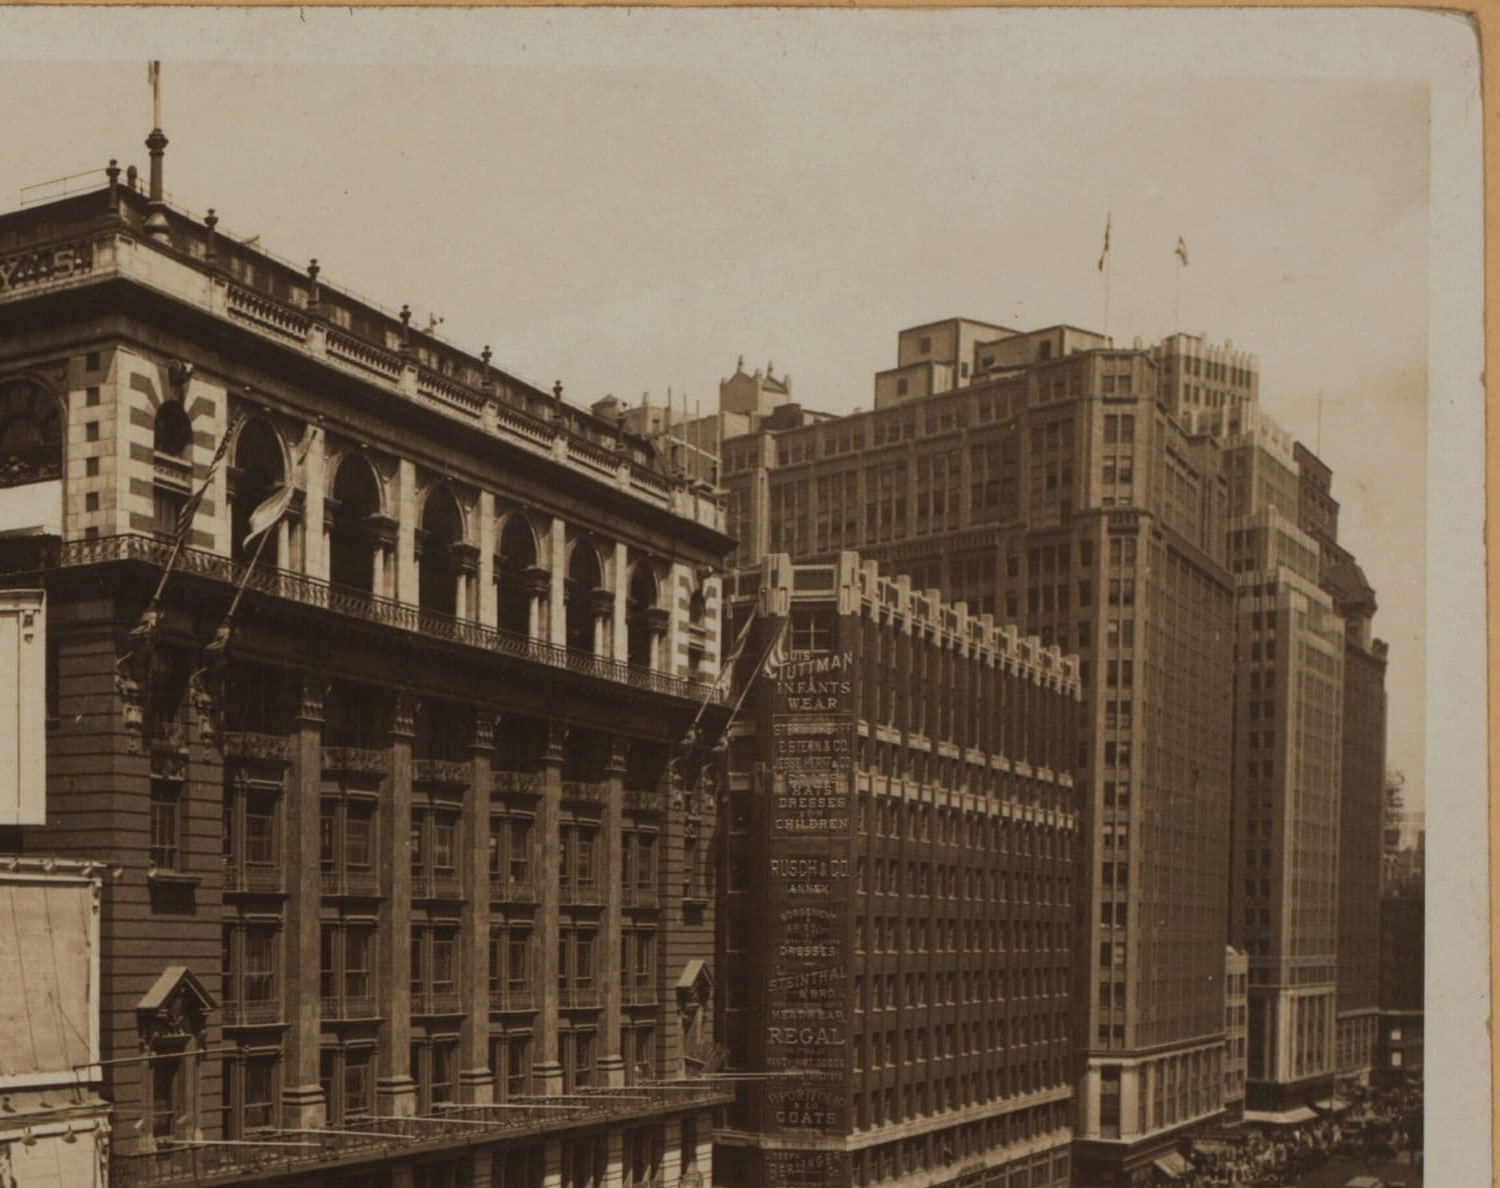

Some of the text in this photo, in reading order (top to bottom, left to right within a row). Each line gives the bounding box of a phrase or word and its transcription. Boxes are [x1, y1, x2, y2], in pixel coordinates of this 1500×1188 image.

[776, 679, 851, 694] INFANTS
[787, 697, 838, 711] WEAR
[778, 798, 846, 809] DRESSES
[774, 818, 849, 830] CHILDREN
[779, 946, 836, 957] DRESSES
[766, 1027, 845, 1046] REGAL
[775, 1111, 837, 1125] COATS
